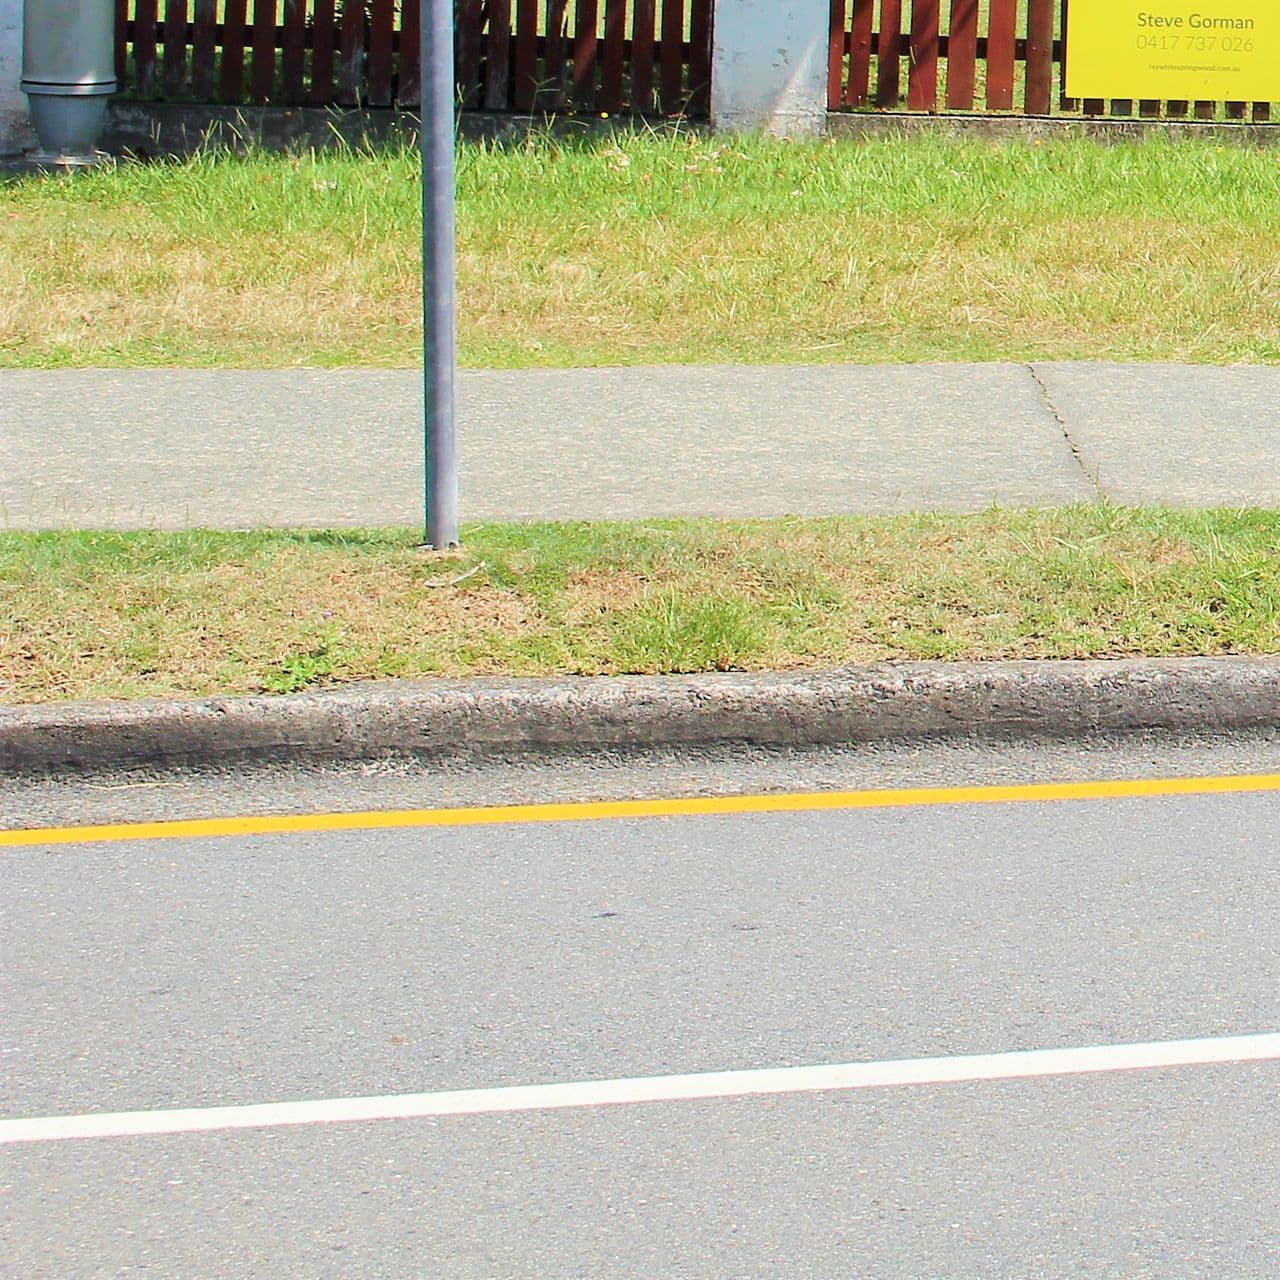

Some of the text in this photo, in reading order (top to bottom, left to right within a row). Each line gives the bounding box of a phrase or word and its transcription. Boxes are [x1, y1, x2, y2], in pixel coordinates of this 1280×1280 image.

[1137, 12, 1255, 30] Steve Gorman
[1136, 34, 1255, 53] 0417 737 026
